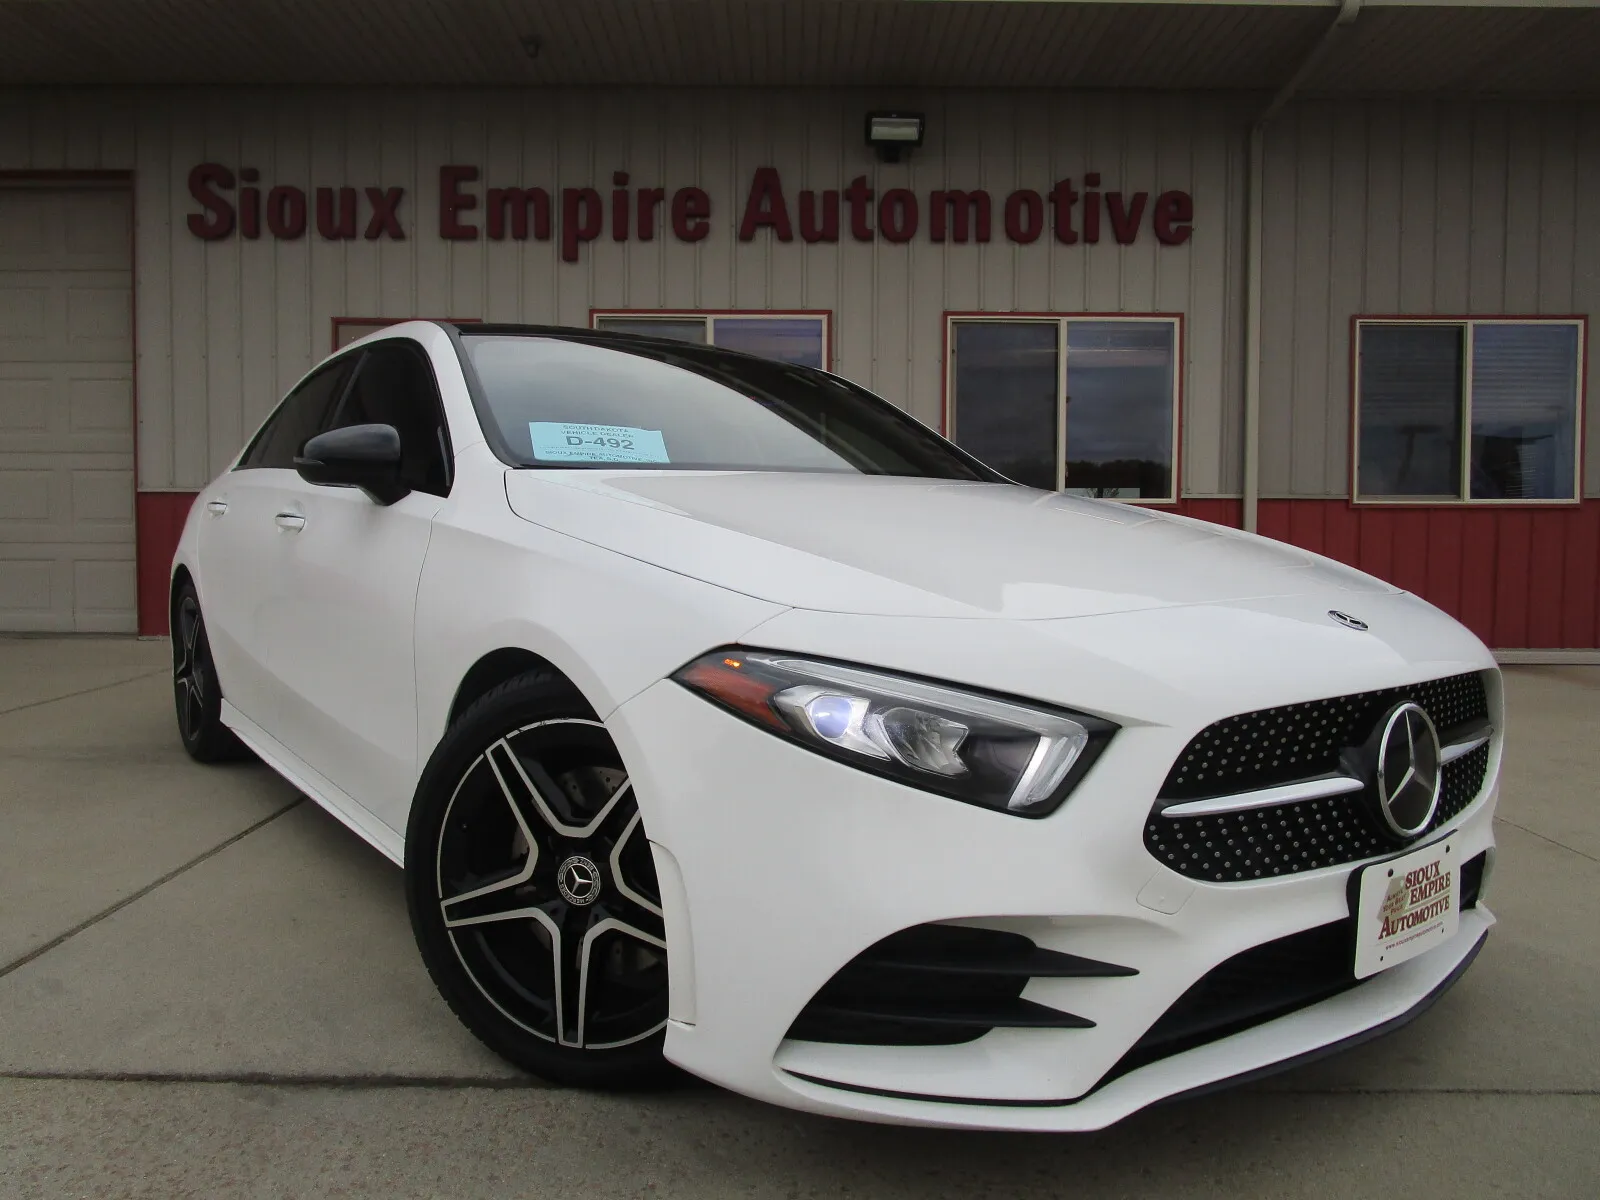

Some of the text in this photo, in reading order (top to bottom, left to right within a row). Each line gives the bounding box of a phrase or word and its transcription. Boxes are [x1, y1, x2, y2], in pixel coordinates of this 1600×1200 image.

[187, 163, 1194, 262] Sioux Empire Automotive
[566, 435, 635, 450] D-492
[1405, 860, 1440, 889] SIOUX
[1409, 871, 1451, 905] EMPIRE
[1378, 895, 1449, 939] AUTOMOTIVE
